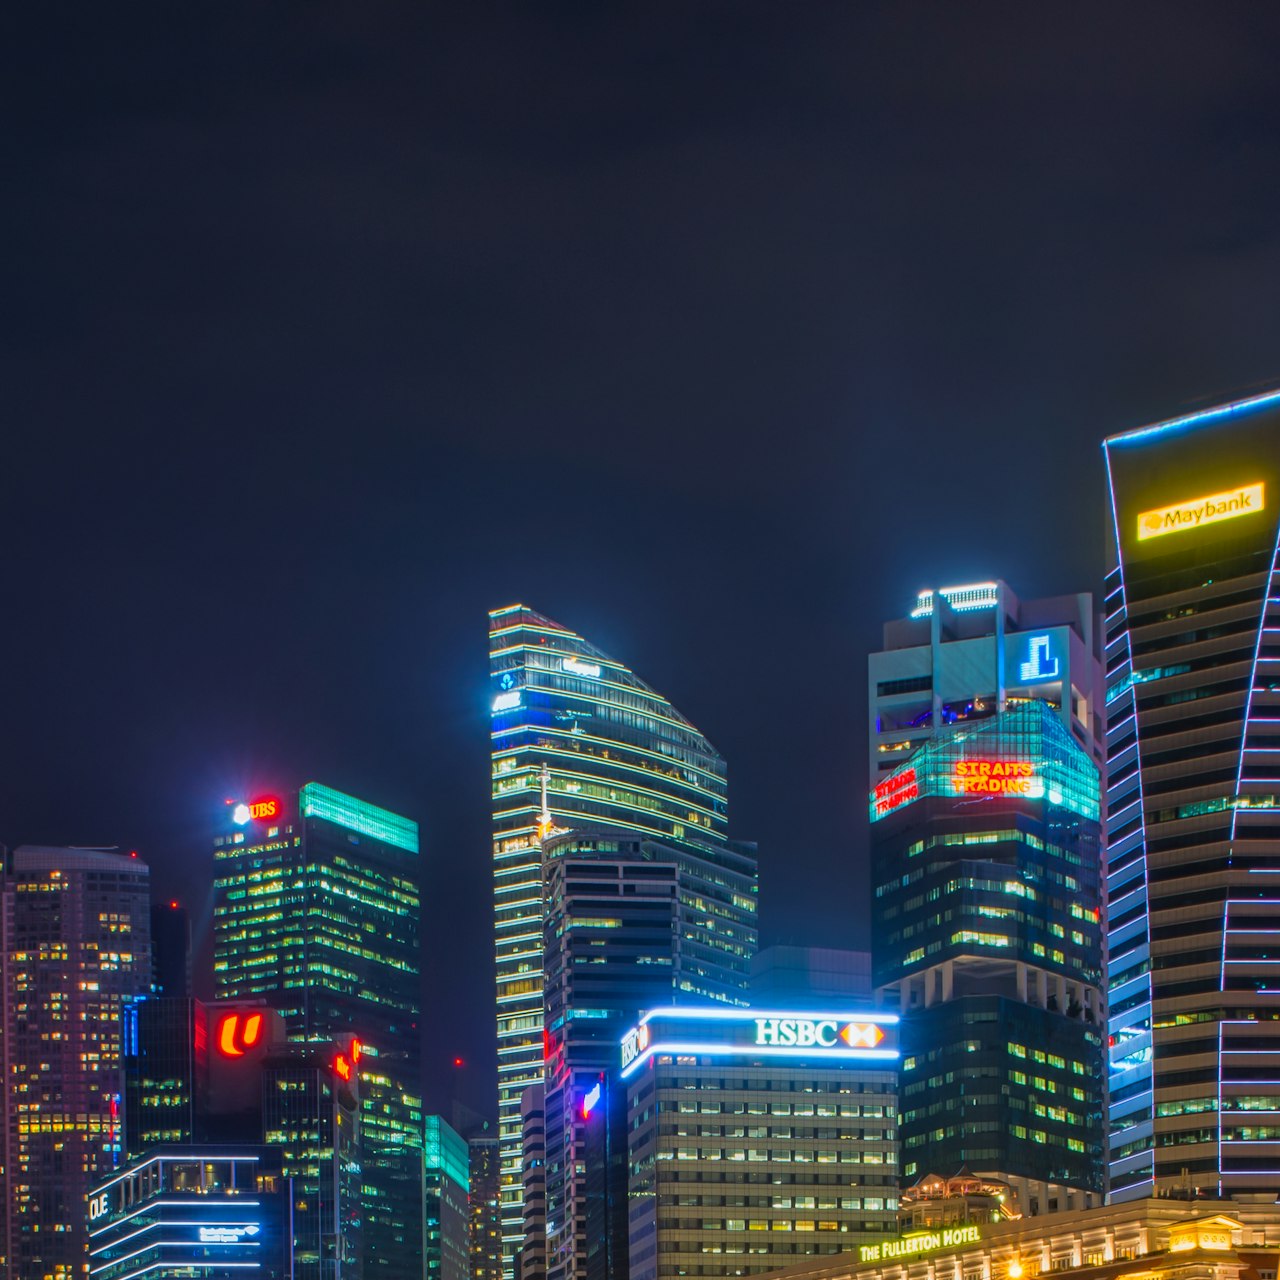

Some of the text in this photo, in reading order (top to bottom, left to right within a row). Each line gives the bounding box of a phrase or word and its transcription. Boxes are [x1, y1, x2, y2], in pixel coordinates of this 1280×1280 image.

[1163, 492, 1252, 528] Maybank
[956, 762, 1032, 777] STRAITS
[952, 777, 1031, 793] TRADING
[249, 801, 276, 819] UBS
[755, 1018, 839, 1048] HSBC
[90, 1193, 109, 1220] OUE
[860, 1226, 980, 1261] THE FULLERTON HOTEL
